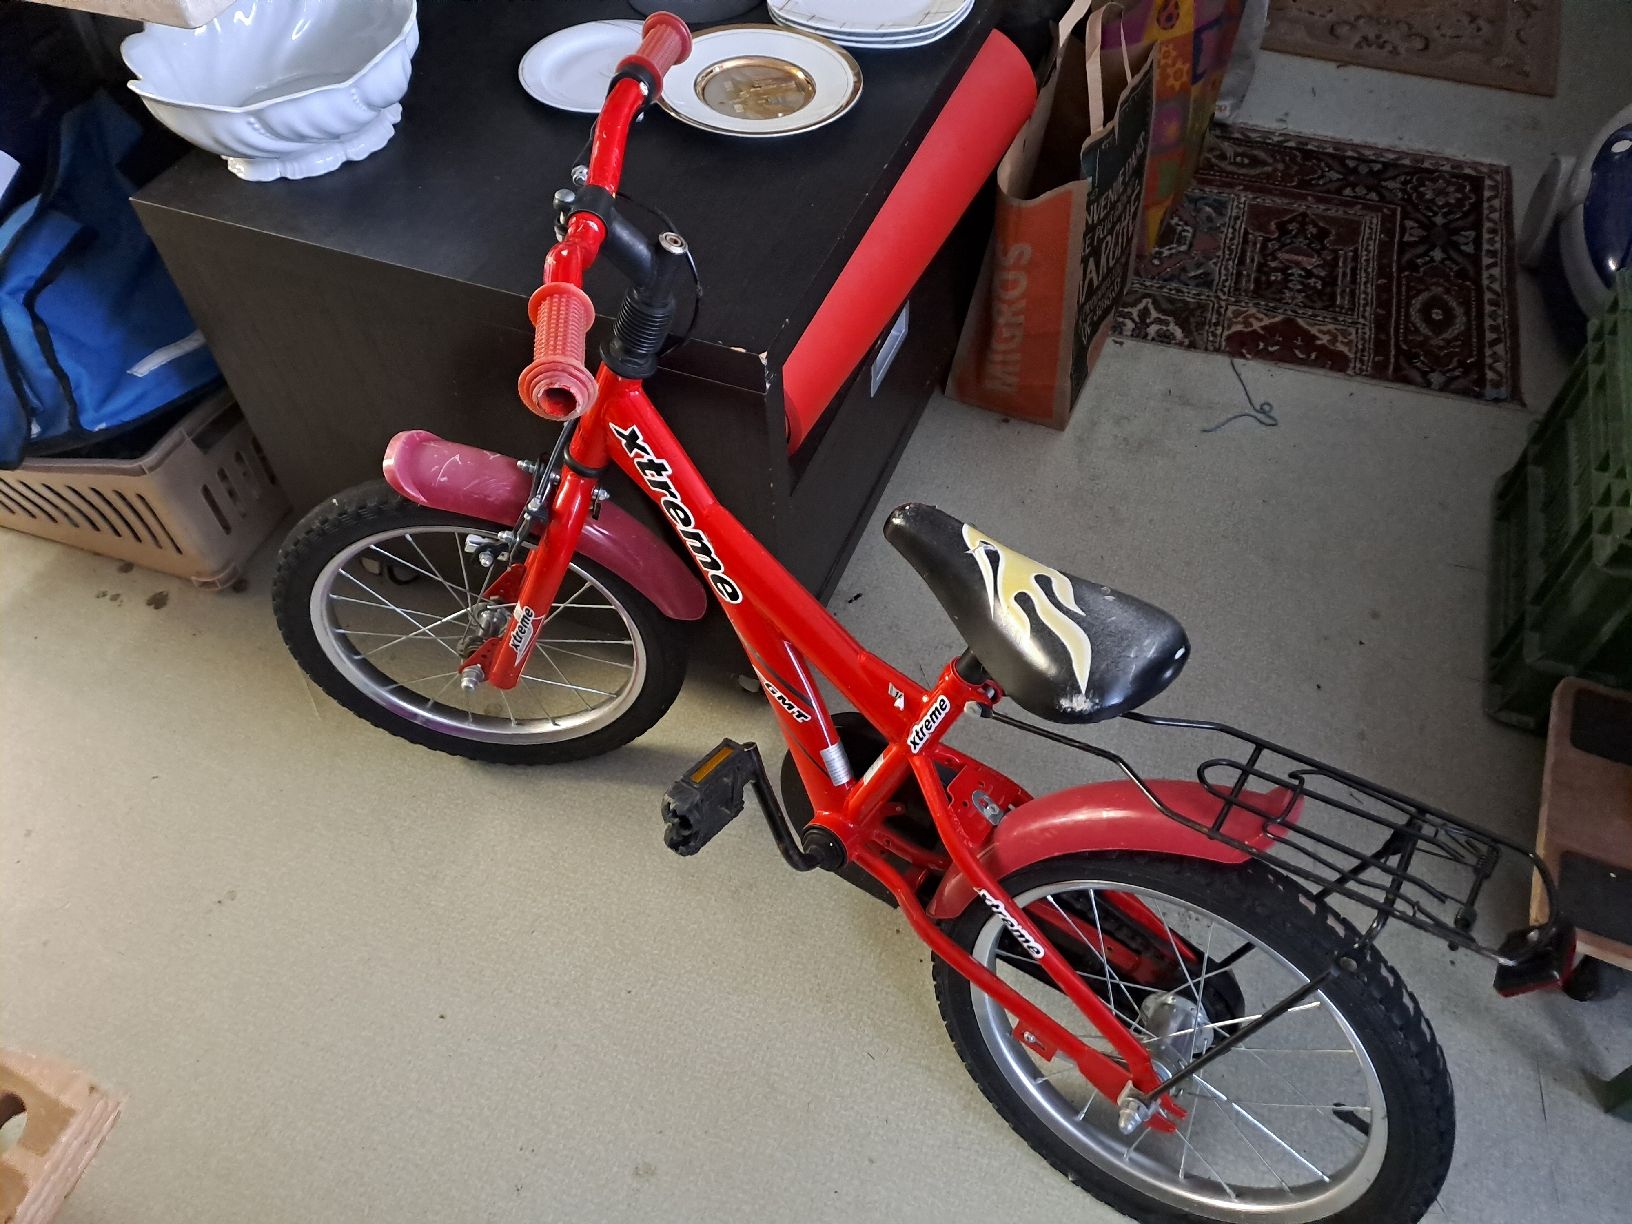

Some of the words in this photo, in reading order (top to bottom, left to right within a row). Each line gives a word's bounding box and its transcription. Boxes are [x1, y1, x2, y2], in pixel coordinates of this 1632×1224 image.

[984, 242, 1032, 395] MIGROS
[609, 422, 743, 604] xtreme
[509, 605, 535, 652] xtreme
[763, 681, 811, 723] GMT
[907, 695, 951, 754] xtreme
